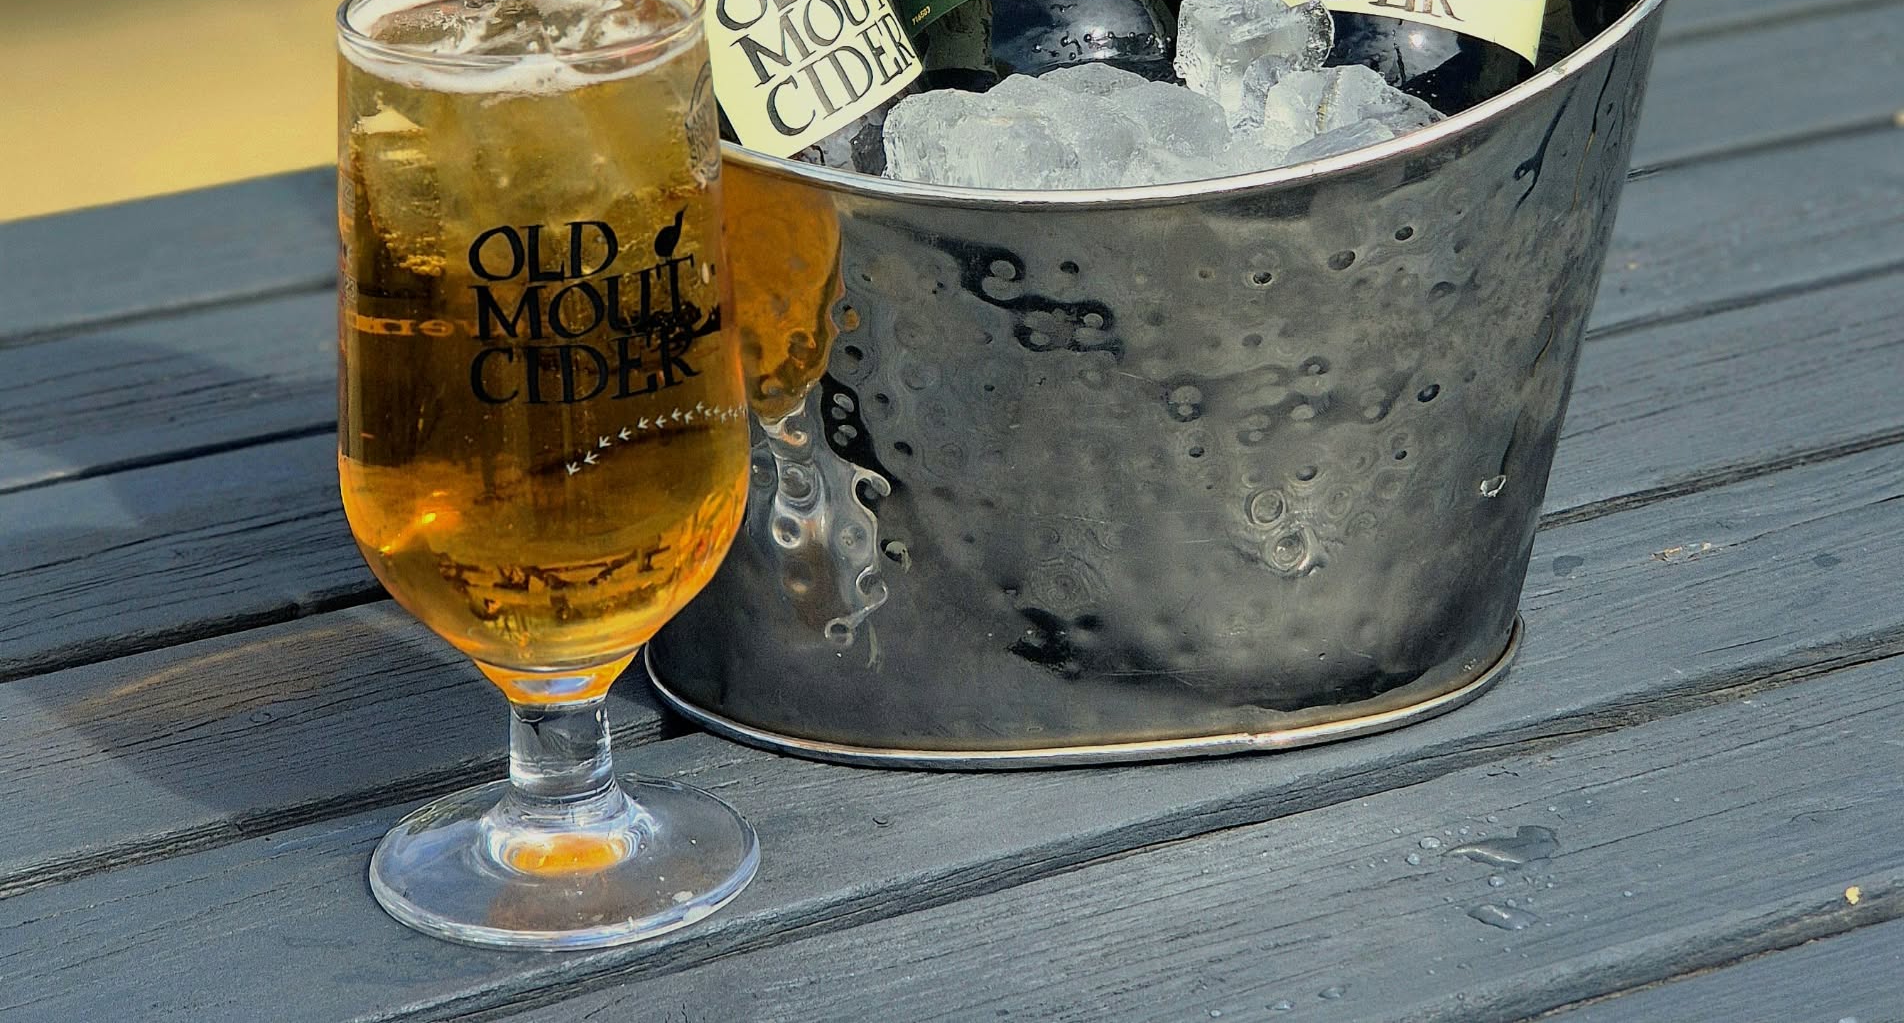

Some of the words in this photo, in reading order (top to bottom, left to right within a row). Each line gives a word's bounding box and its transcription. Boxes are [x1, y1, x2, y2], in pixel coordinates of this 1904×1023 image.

[766, 13, 915, 136] CIDER
[468, 220, 619, 282] OLD
[467, 253, 695, 341] MOUT
[470, 329, 701, 405] CIDER
